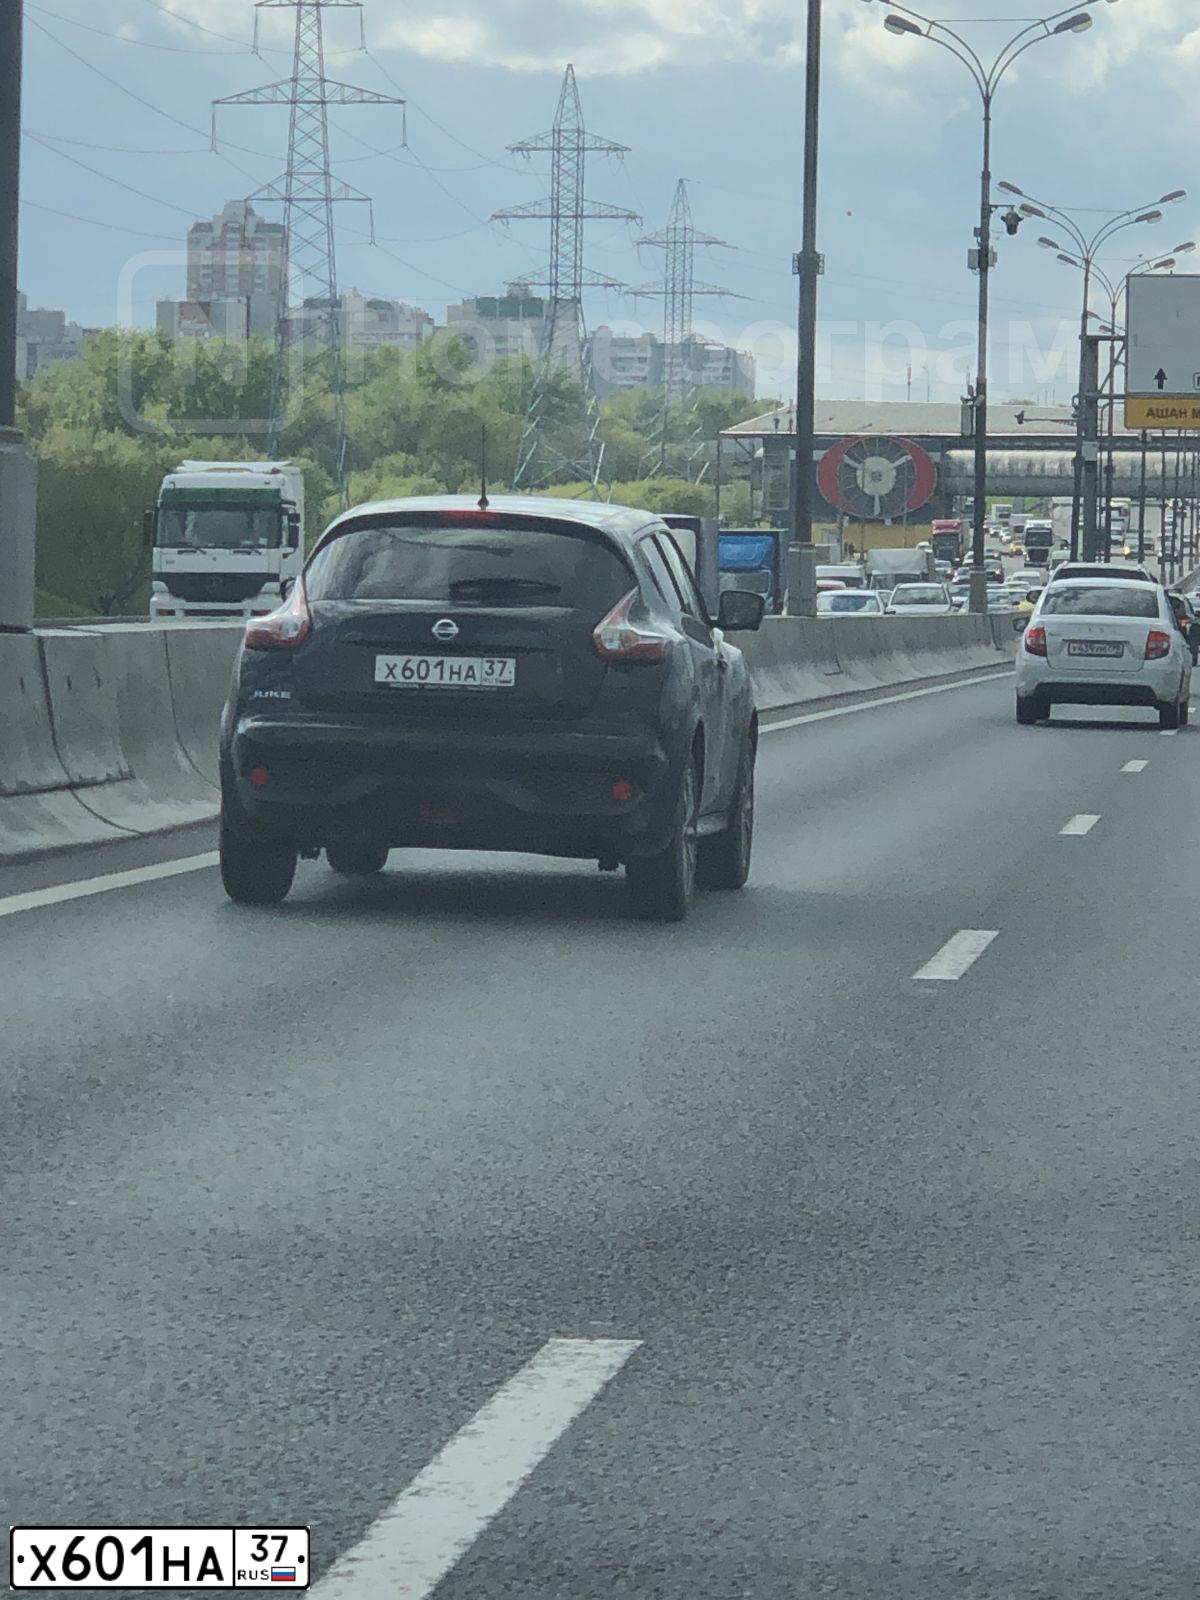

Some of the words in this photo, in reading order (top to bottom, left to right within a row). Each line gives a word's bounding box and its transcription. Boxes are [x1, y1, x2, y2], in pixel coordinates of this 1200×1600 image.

[1145, 408, 1187, 418] АШАН
[384, 659, 477, 682] Х601НА
[485, 660, 507, 676] 37
[253, 690, 291, 699] JUKE
